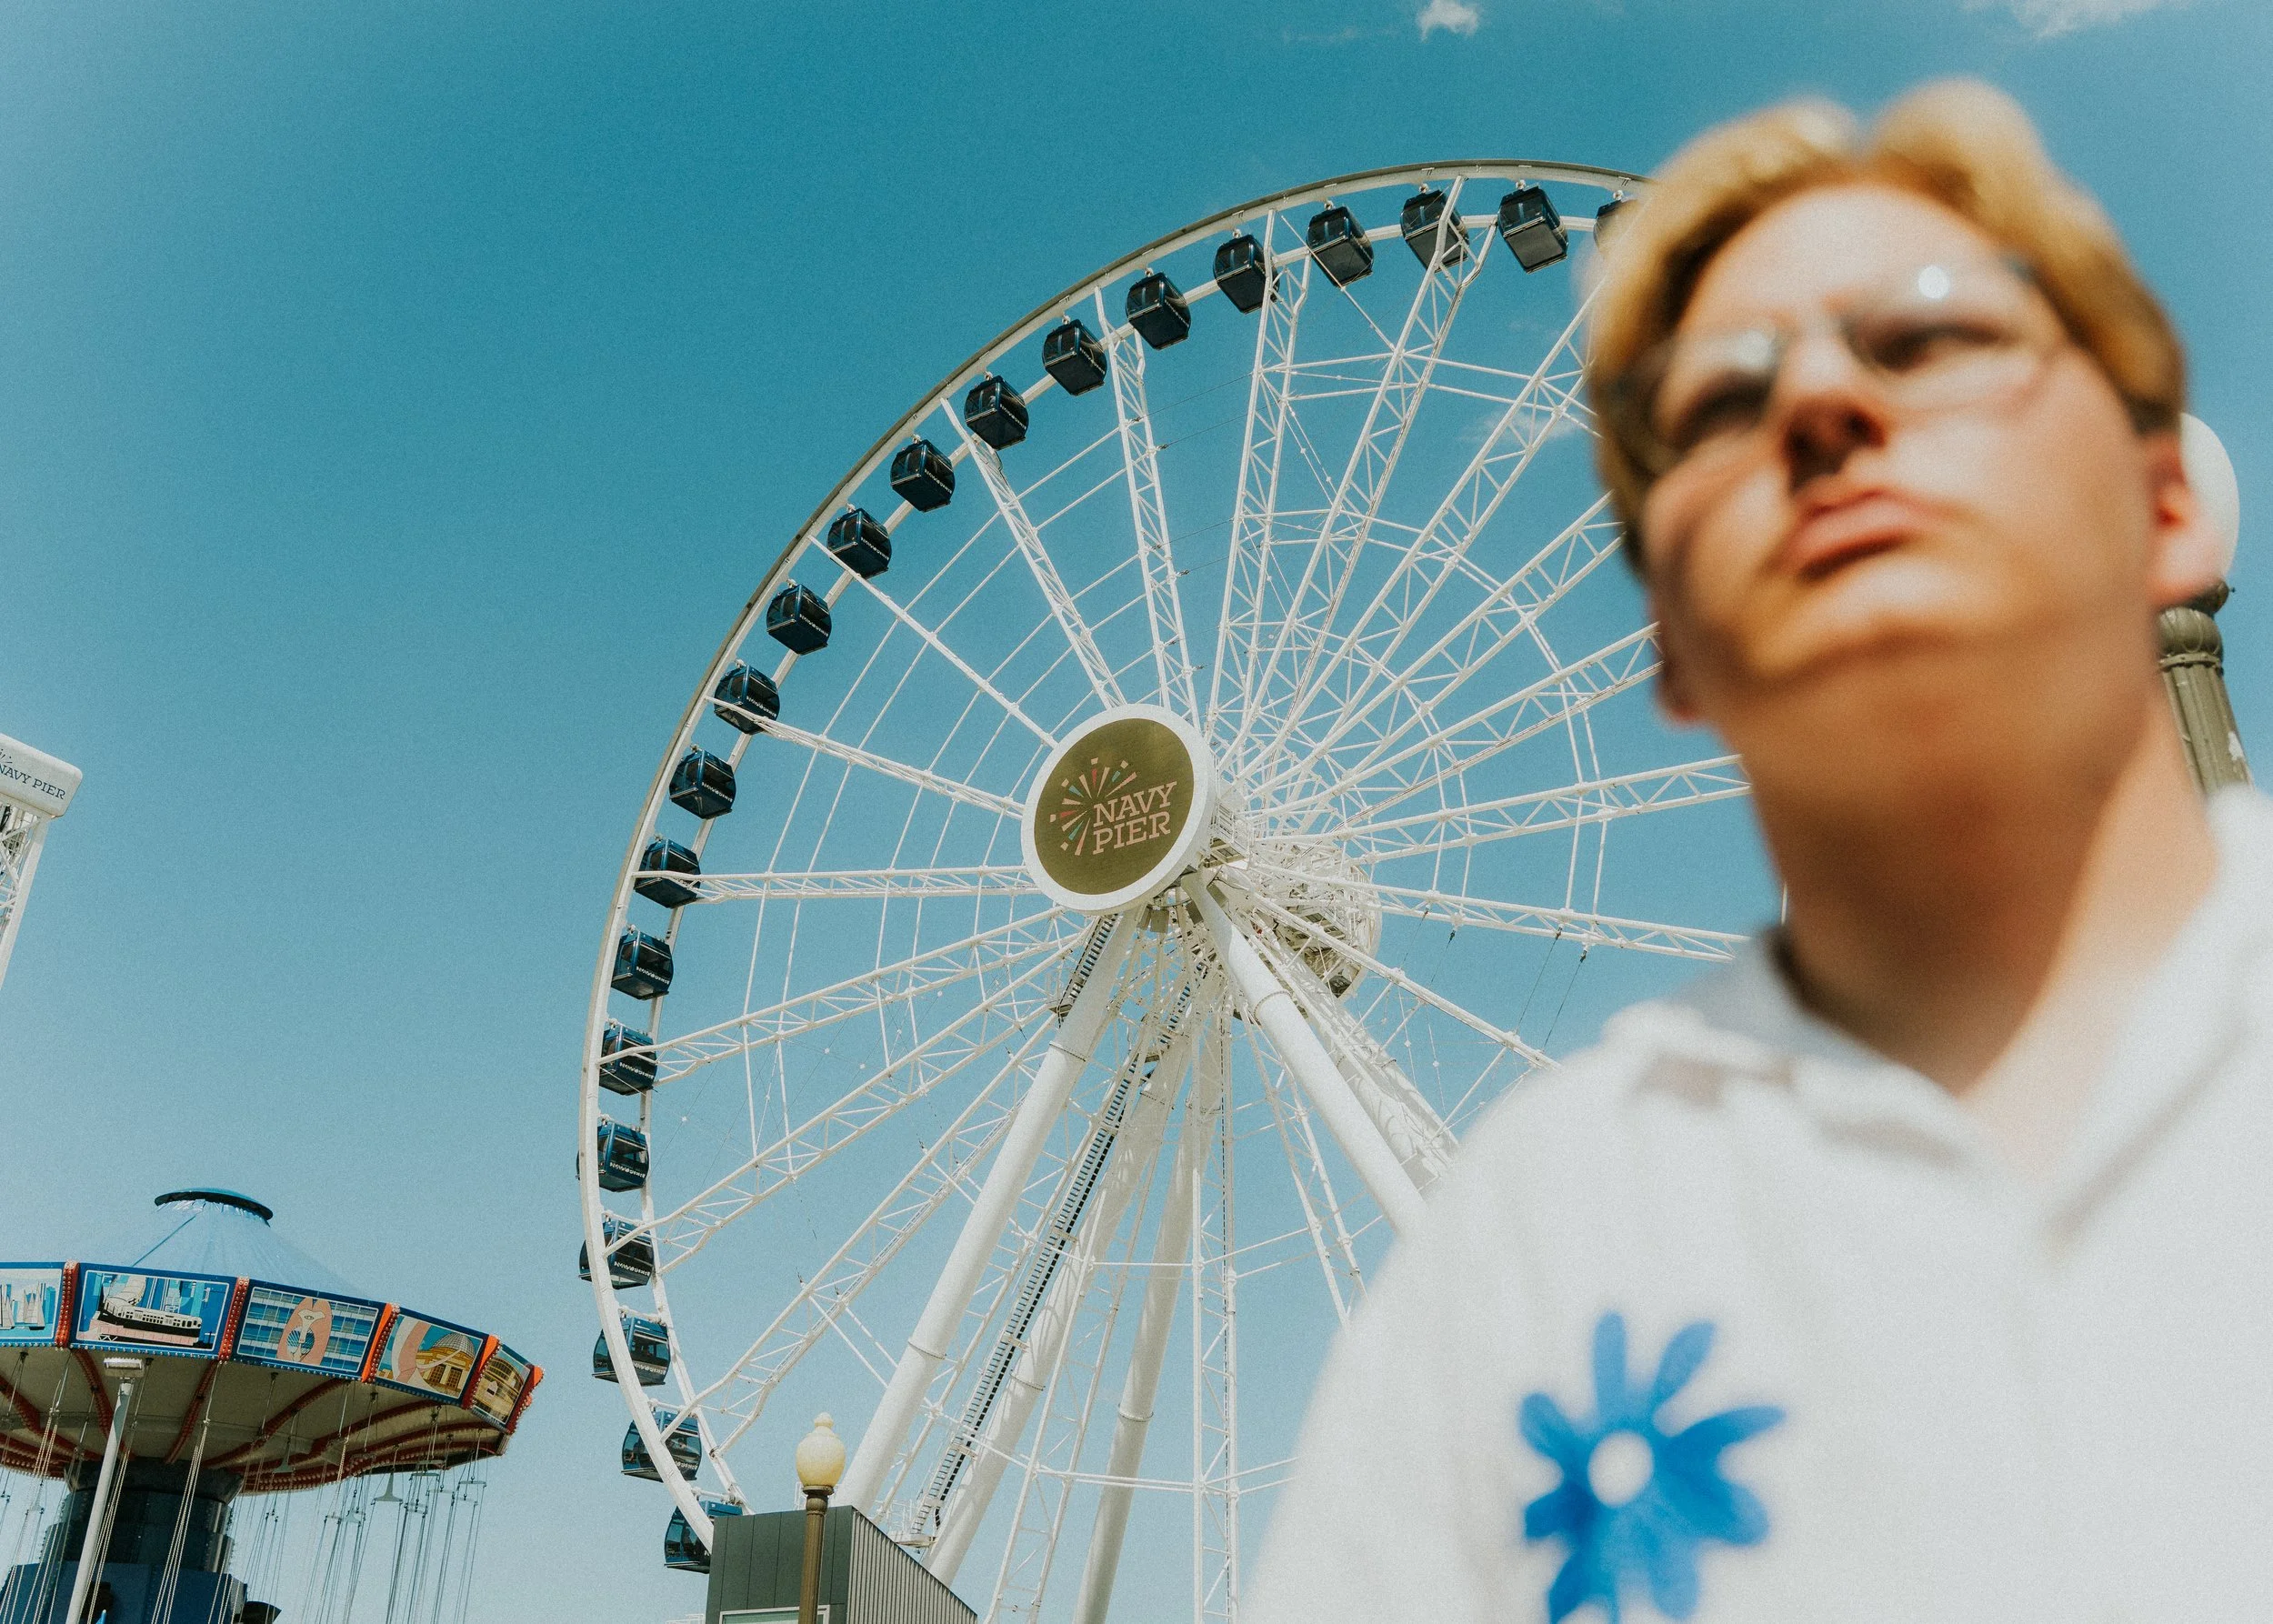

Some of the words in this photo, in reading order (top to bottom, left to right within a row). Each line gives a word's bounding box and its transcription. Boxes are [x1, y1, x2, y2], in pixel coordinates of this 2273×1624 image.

[32, 777, 66, 799] PIER
[1093, 781, 1177, 827] NAVY
[1092, 811, 1171, 855] PIER
